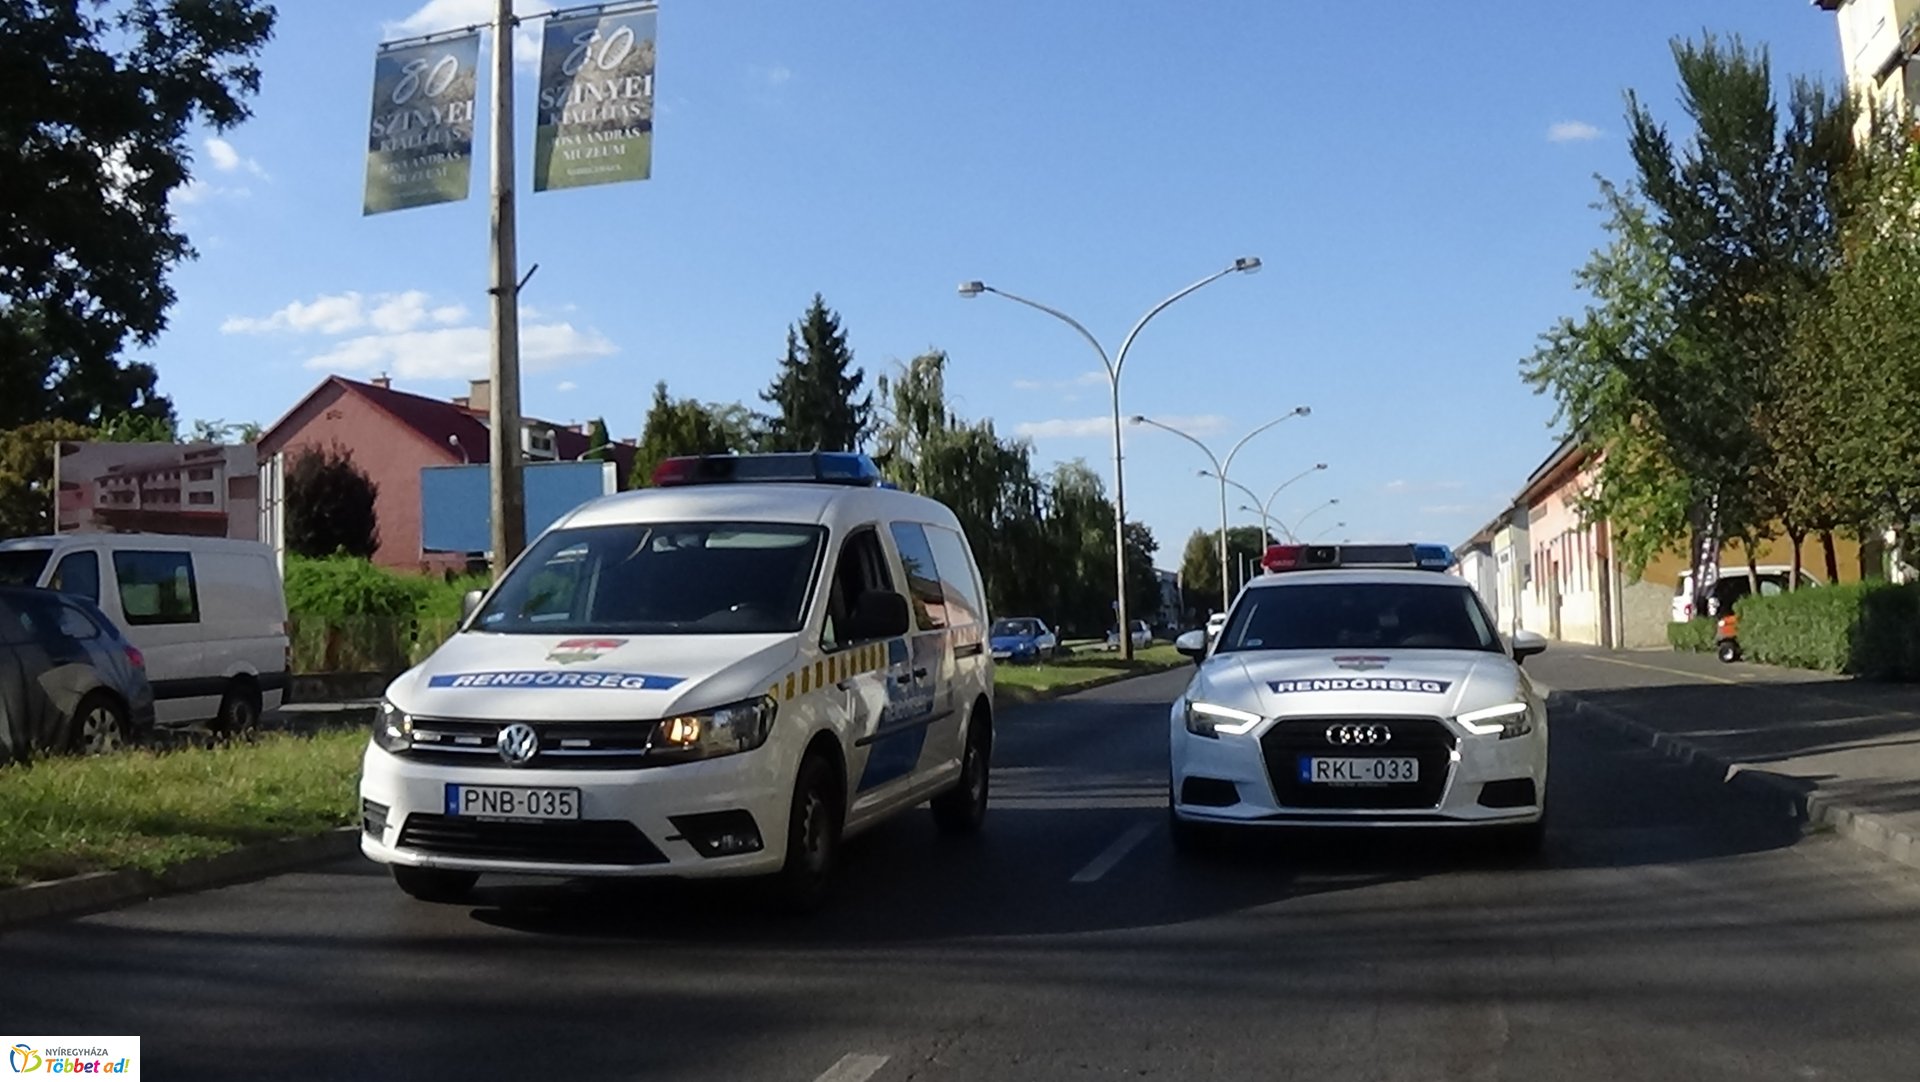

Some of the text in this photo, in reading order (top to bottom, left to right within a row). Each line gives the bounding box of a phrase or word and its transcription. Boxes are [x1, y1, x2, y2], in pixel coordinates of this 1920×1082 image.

[562, 25, 635, 76] 80
[392, 54, 459, 105] 80
[540, 75, 652, 110] SZINYEI
[371, 101, 472, 138] SZINYEI
[1316, 760, 1413, 780] RKL-033
[464, 789, 573, 816] PNB-035
